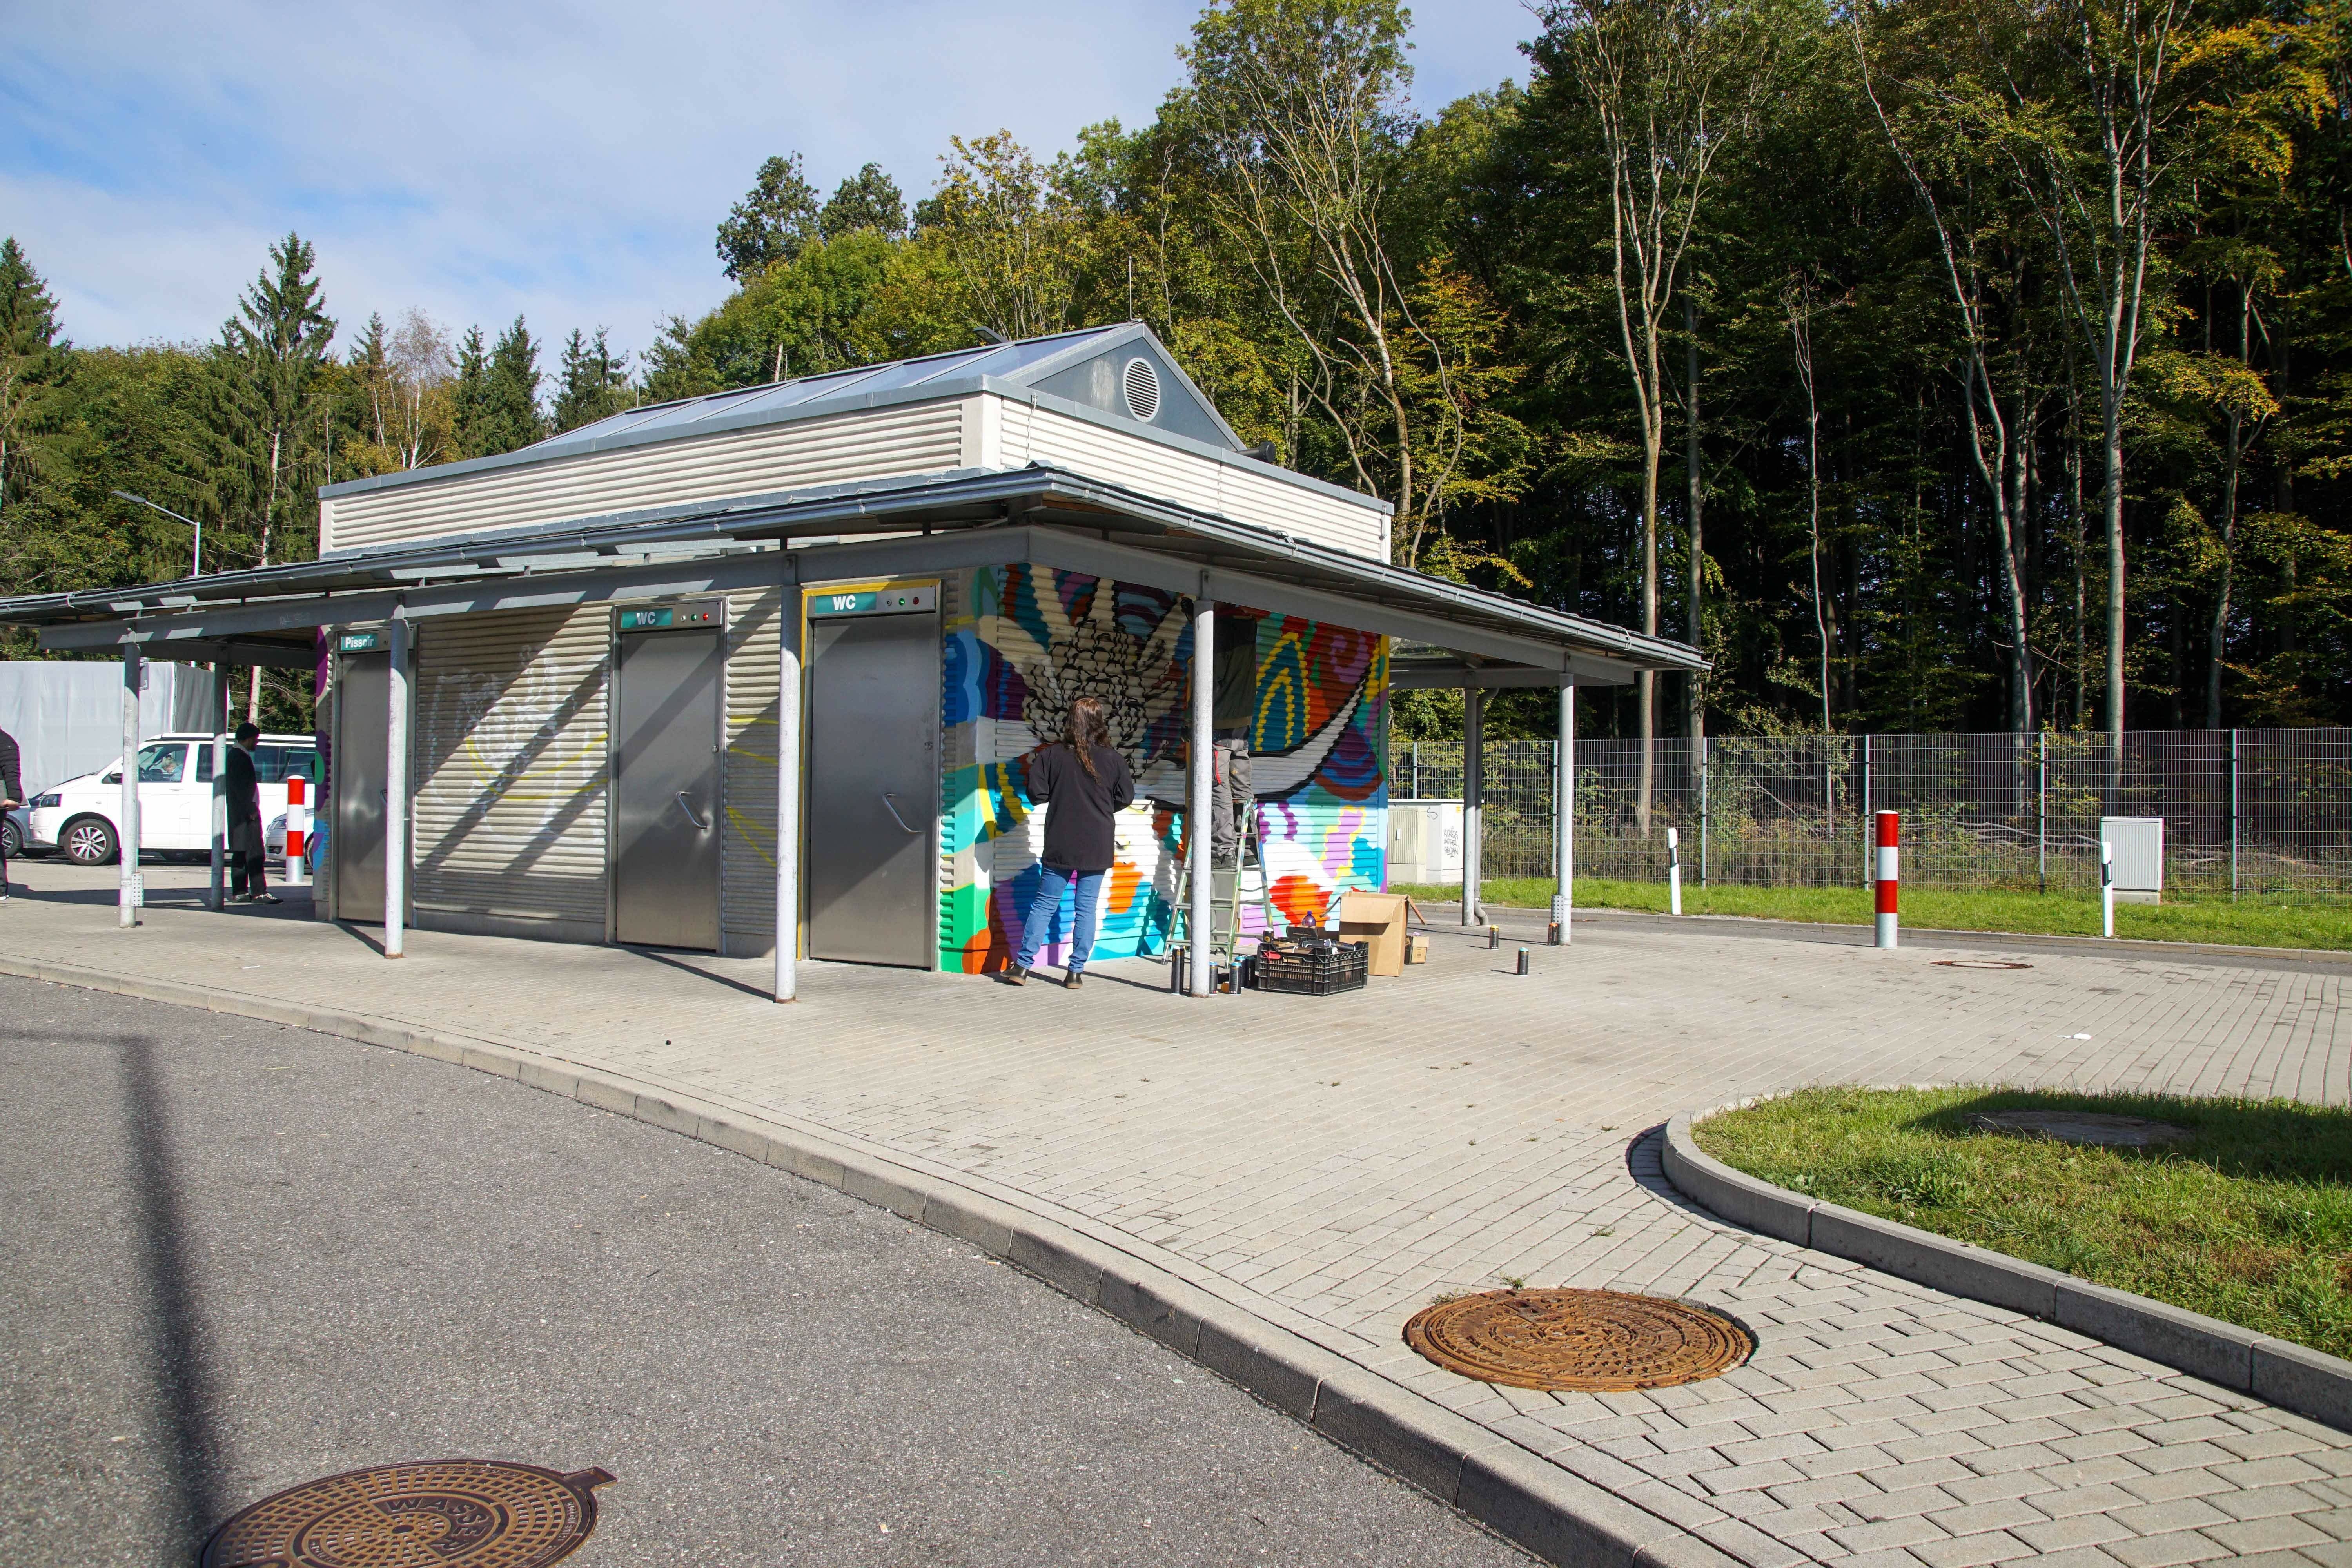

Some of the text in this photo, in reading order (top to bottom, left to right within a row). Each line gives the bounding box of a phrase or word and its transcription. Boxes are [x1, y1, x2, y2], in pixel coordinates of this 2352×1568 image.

[833, 595, 856, 610] WC
[637, 611, 655, 625] WC
[345, 636, 374, 648] Pissoir
[386, 1497, 490, 1550] WASSER
